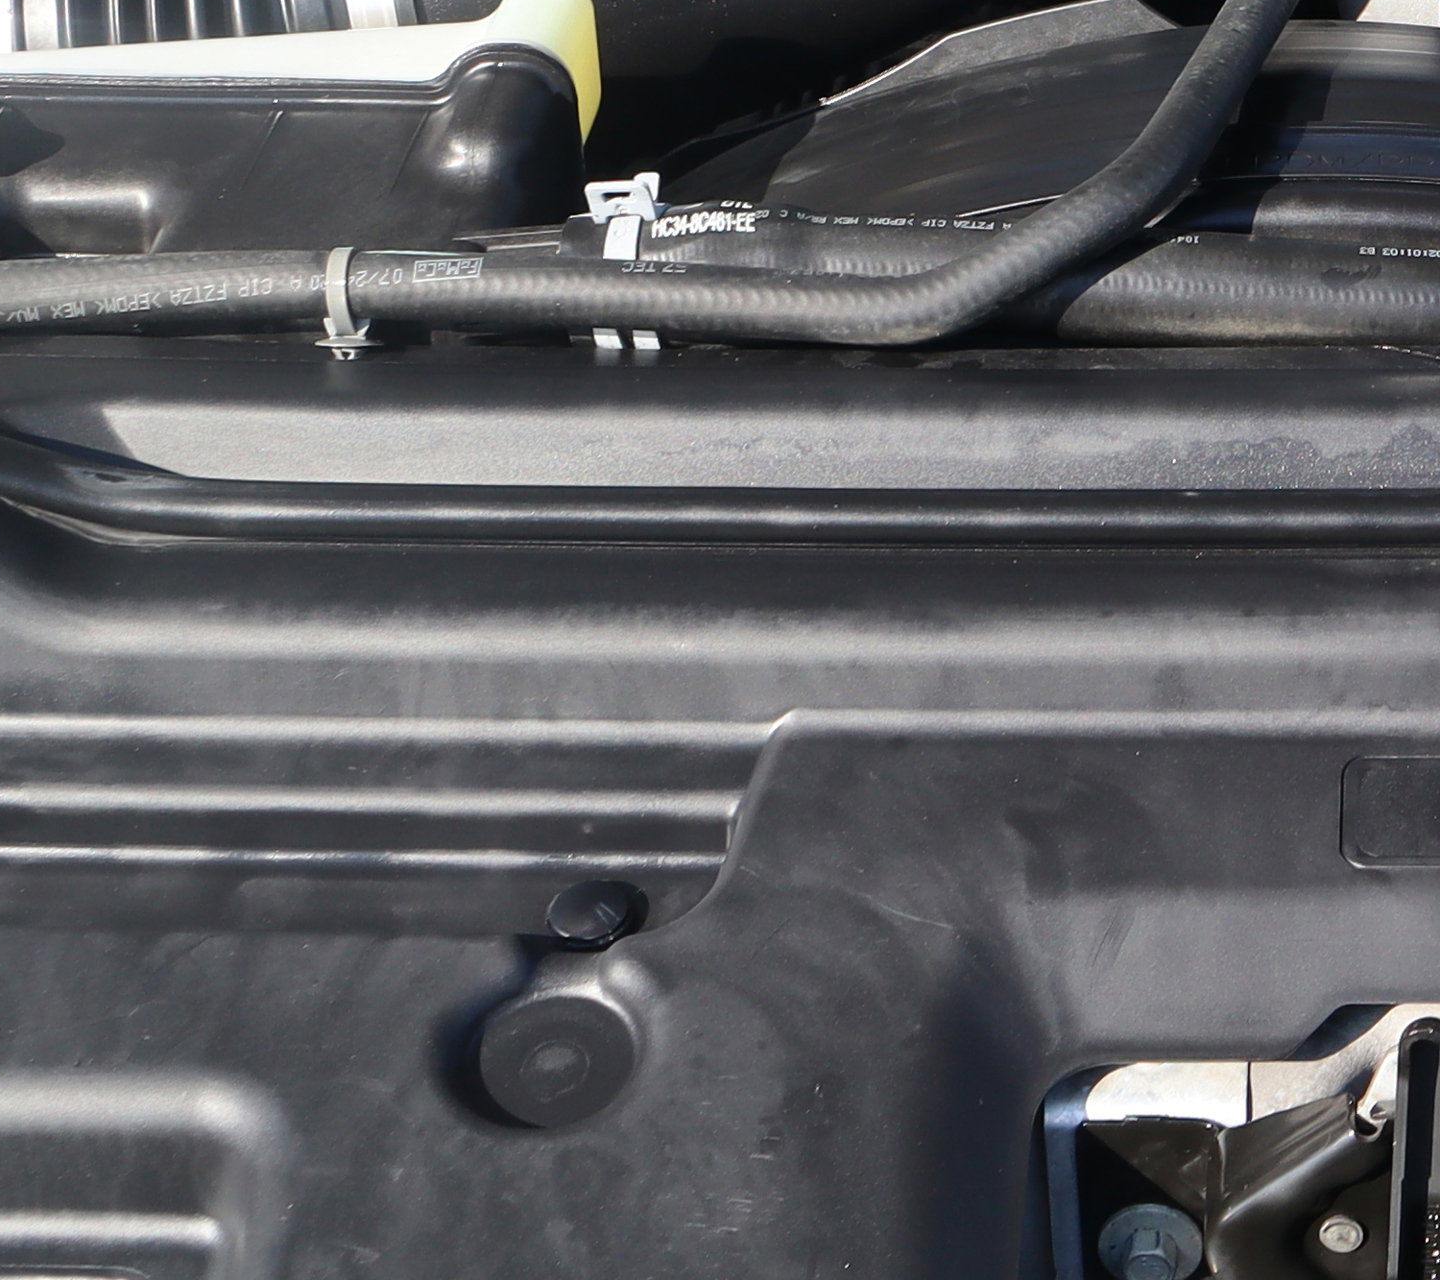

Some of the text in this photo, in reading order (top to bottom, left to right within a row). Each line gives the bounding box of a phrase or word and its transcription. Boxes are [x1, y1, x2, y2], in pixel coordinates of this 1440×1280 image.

[834, 216, 859, 225] MEX
[167, 282, 227, 306] FZTZA
[238, 277, 272, 297] CIP
[50, 300, 86, 319] MEX
